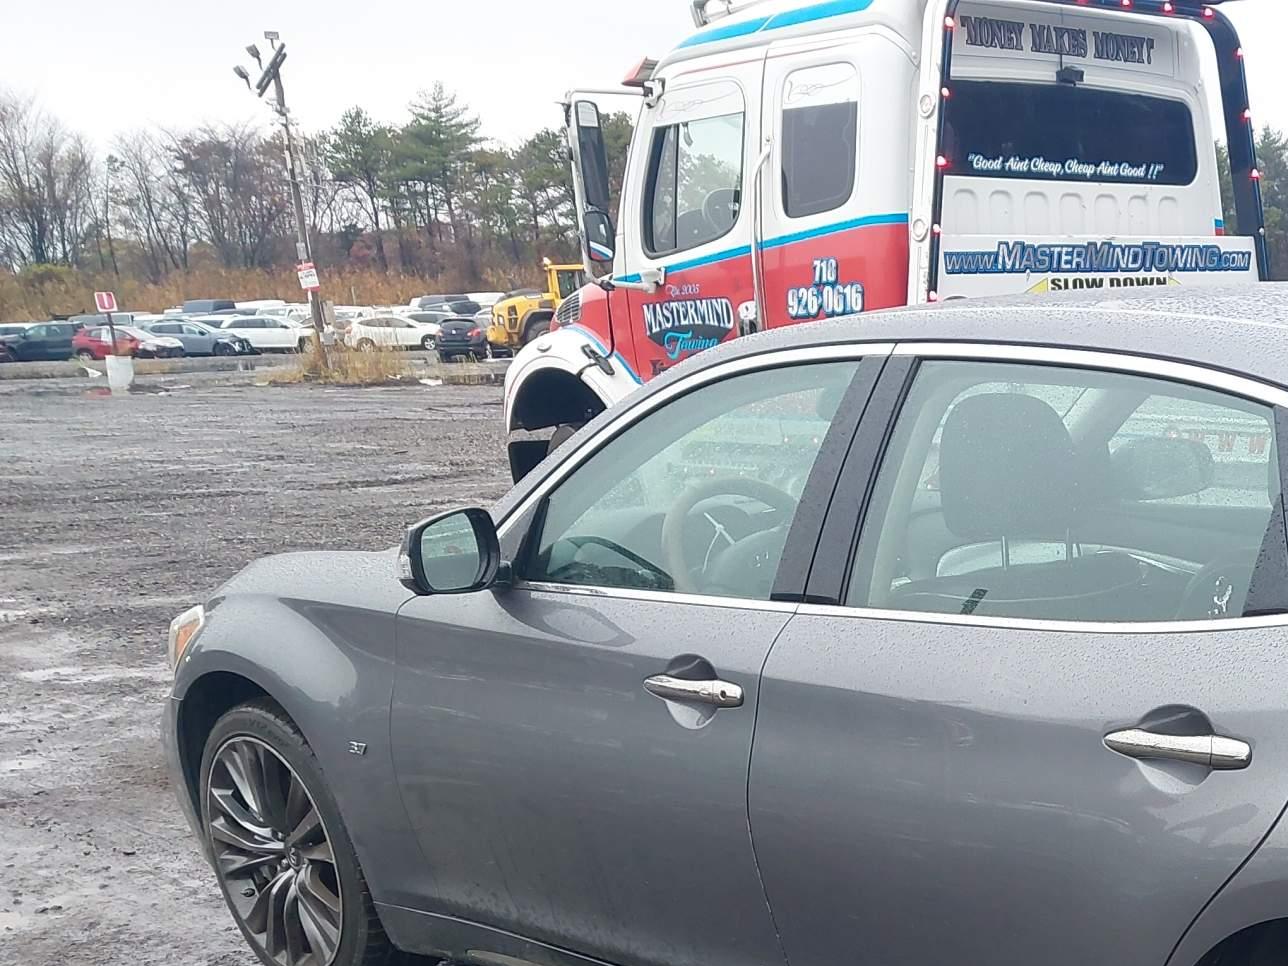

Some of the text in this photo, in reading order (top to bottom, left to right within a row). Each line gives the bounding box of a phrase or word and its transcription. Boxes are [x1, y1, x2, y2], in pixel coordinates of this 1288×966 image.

[1029, 23, 1088, 58] MAKES
[1005, 156, 1029, 171] Aint
[1096, 160, 1119, 175] Aint
[1119, 162, 1146, 177] Good
[642, 297, 734, 337] MASTERMIND
